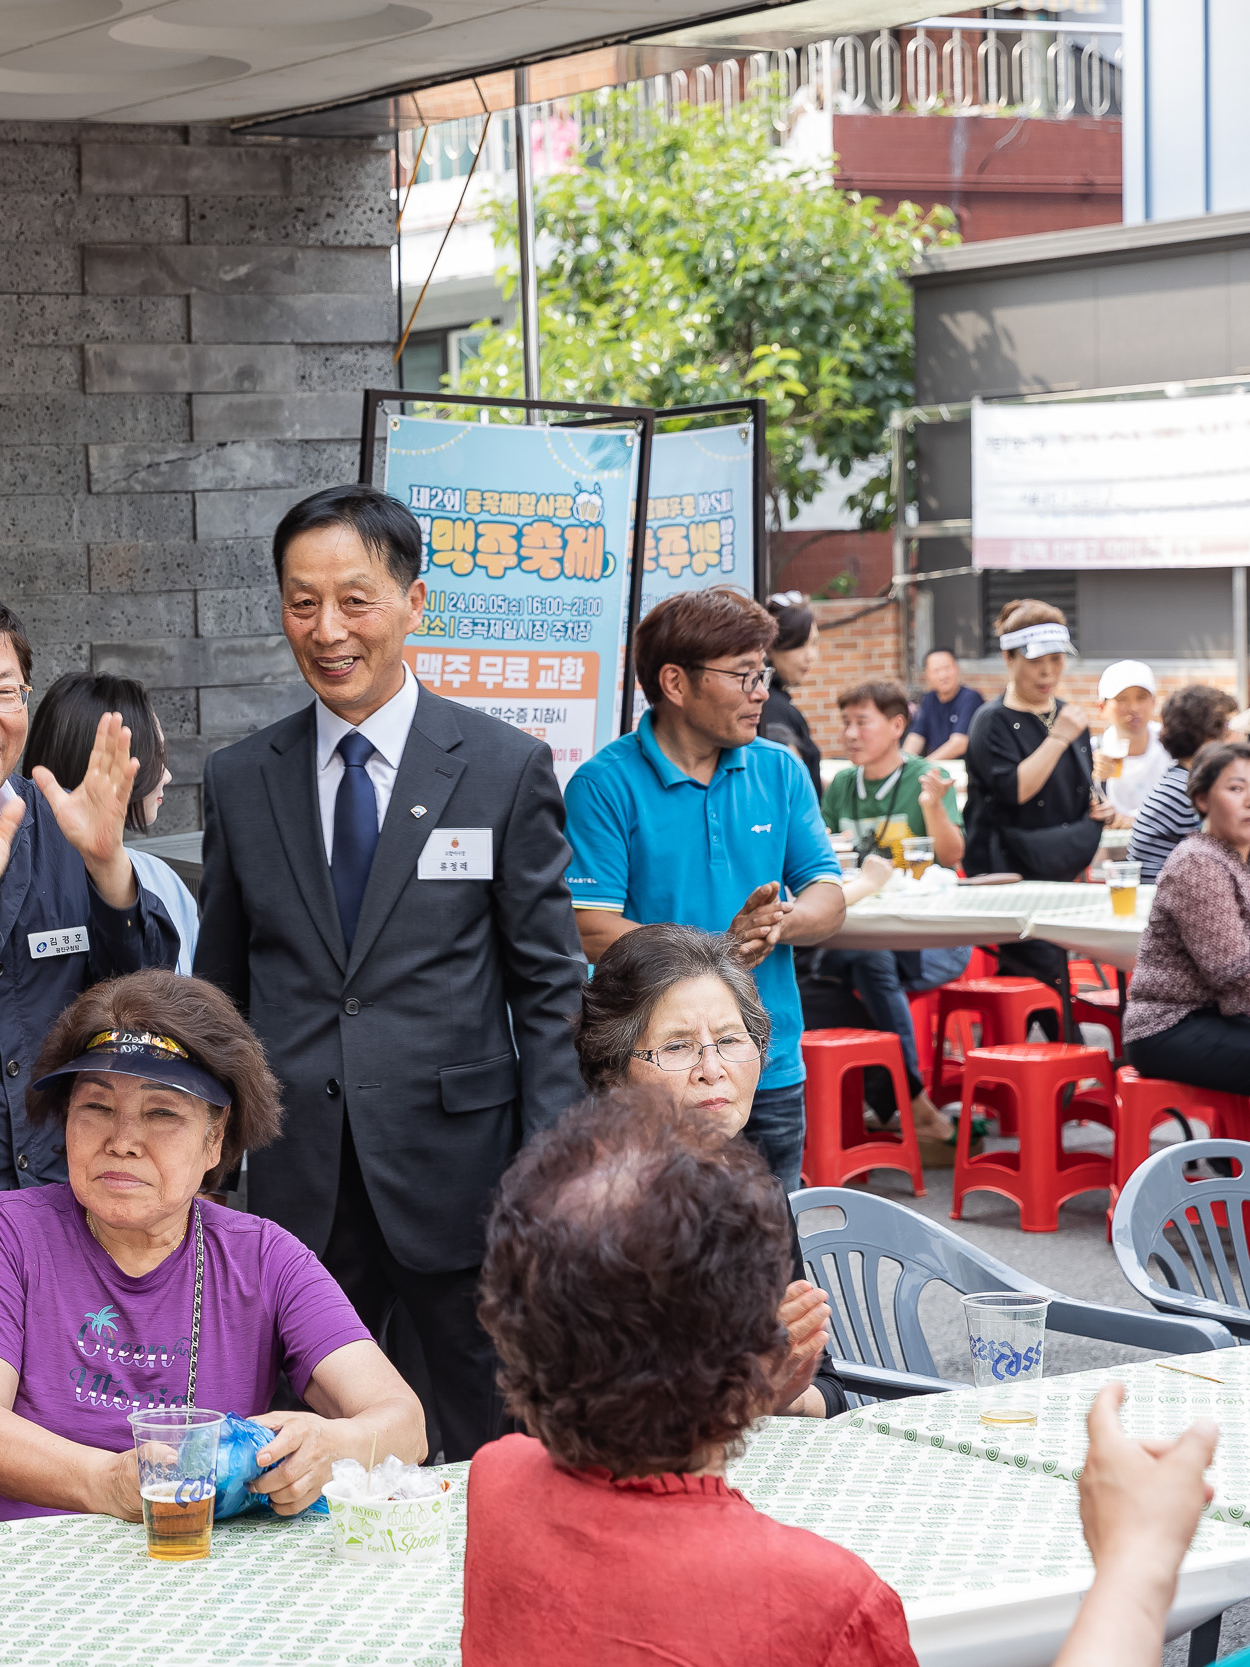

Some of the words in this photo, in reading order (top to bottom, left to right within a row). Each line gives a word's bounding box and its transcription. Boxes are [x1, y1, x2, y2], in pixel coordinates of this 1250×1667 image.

[410, 485, 462, 513] 제2회
[464, 489, 574, 518] 중곡제일시장
[431, 518, 606, 581] 맥주축제
[449, 593, 524, 614] 24.06.05(수)
[527, 596, 602, 616] 16:00~21:00
[458, 618, 548, 640] 중곡제일시장
[551, 620, 591, 641] 주차장
[416, 653, 471, 688] 맥주
[477, 656, 530, 689] 무료
[536, 656, 585, 691] 교환
[532, 707, 567, 724] 지참시
[77, 1321, 176, 1369] Green
[351, 1505, 380, 1520] ONION
[367, 1545, 385, 1553] Fork
[398, 1532, 441, 1556] Spoon
